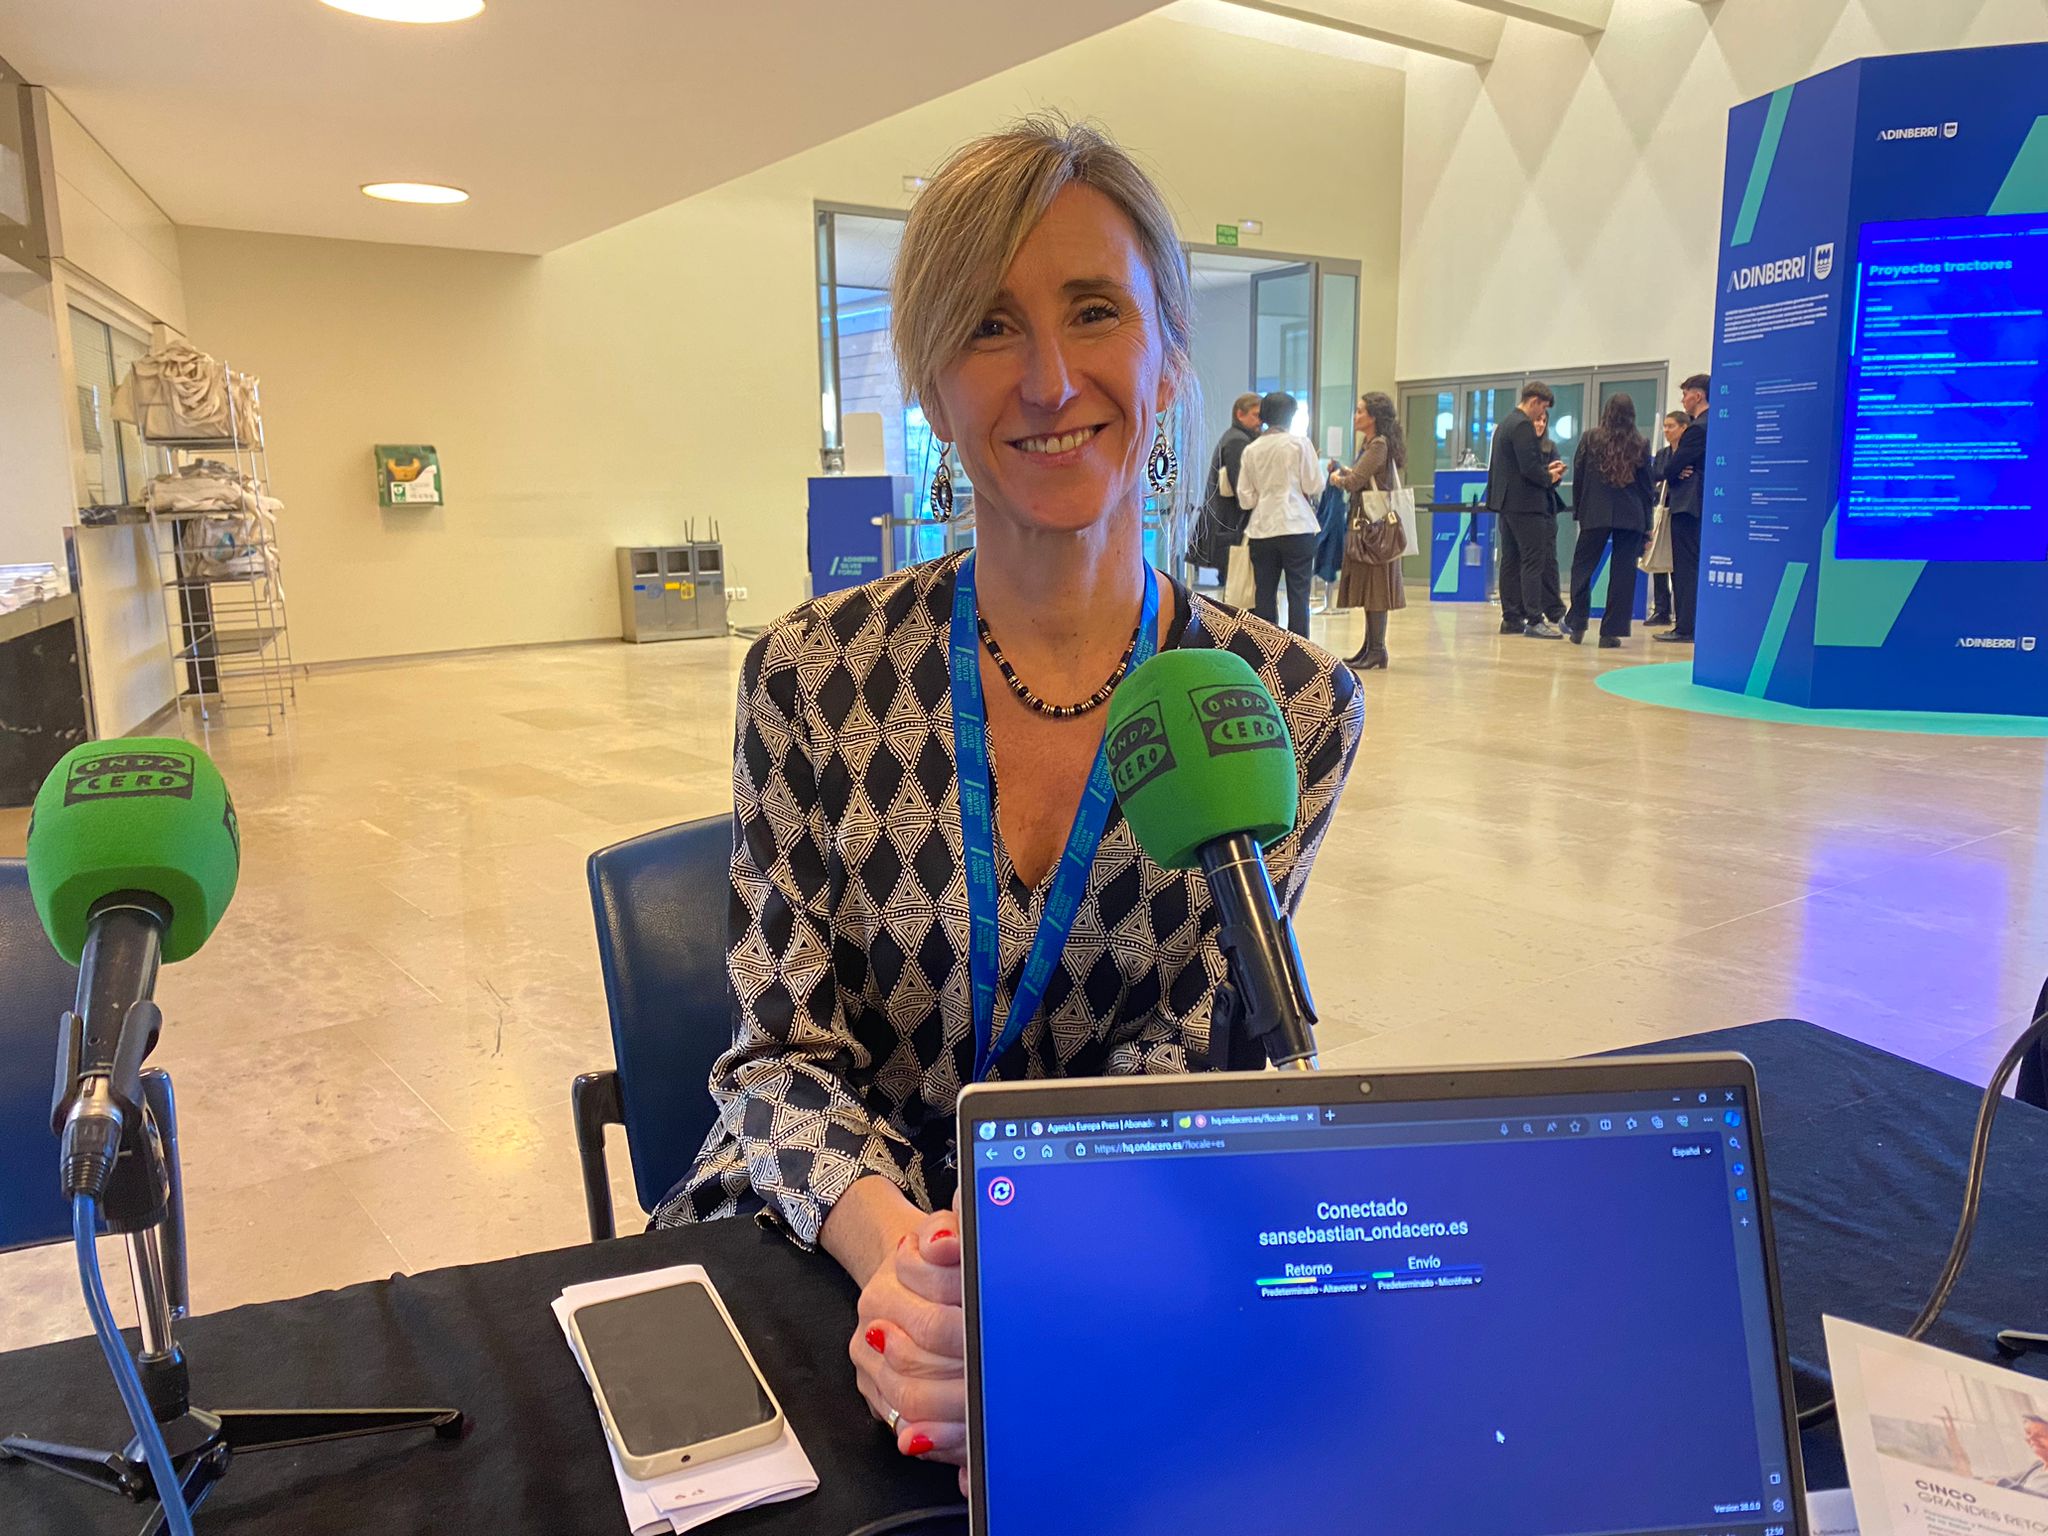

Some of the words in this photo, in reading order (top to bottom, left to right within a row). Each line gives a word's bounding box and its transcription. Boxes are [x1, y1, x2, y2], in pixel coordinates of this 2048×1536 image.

[1876, 126, 1938, 141] ADINBERRI
[1726, 255, 1806, 293] ADINBERRI
[1869, 264, 1941, 278] Proyectos
[1944, 260, 2013, 272] tractores
[1955, 637, 2016, 649] ADINBERRI
[1208, 698, 1265, 712] ONDA
[1221, 721, 1275, 740] CERO
[1109, 722, 1150, 759] ONDA
[85, 759, 174, 772] ONDA
[1118, 748, 1158, 785] CERO
[88, 775, 175, 790] CERO
[1048, 1122, 1075, 1135] Agencia
[1076, 1120, 1101, 1133] Europa
[1101, 1119, 1119, 1130] Press
[1672, 1145, 1700, 1157] Español
[1317, 1197, 1408, 1221] Conectado
[1259, 1221, 1469, 1247] sansebastian_ondacero.es
[1285, 1262, 1333, 1277] Retorno
[1408, 1254, 1441, 1270] Envío
[1261, 1285, 1318, 1297] Predeterminado
[1323, 1283, 1358, 1294] Altavoces
[1377, 1278, 1434, 1290] Predeterminado
[1915, 1479, 1977, 1503] CINCO
[1713, 1503, 1739, 1513] Version
[1917, 1491, 2001, 1522] GRANDES
